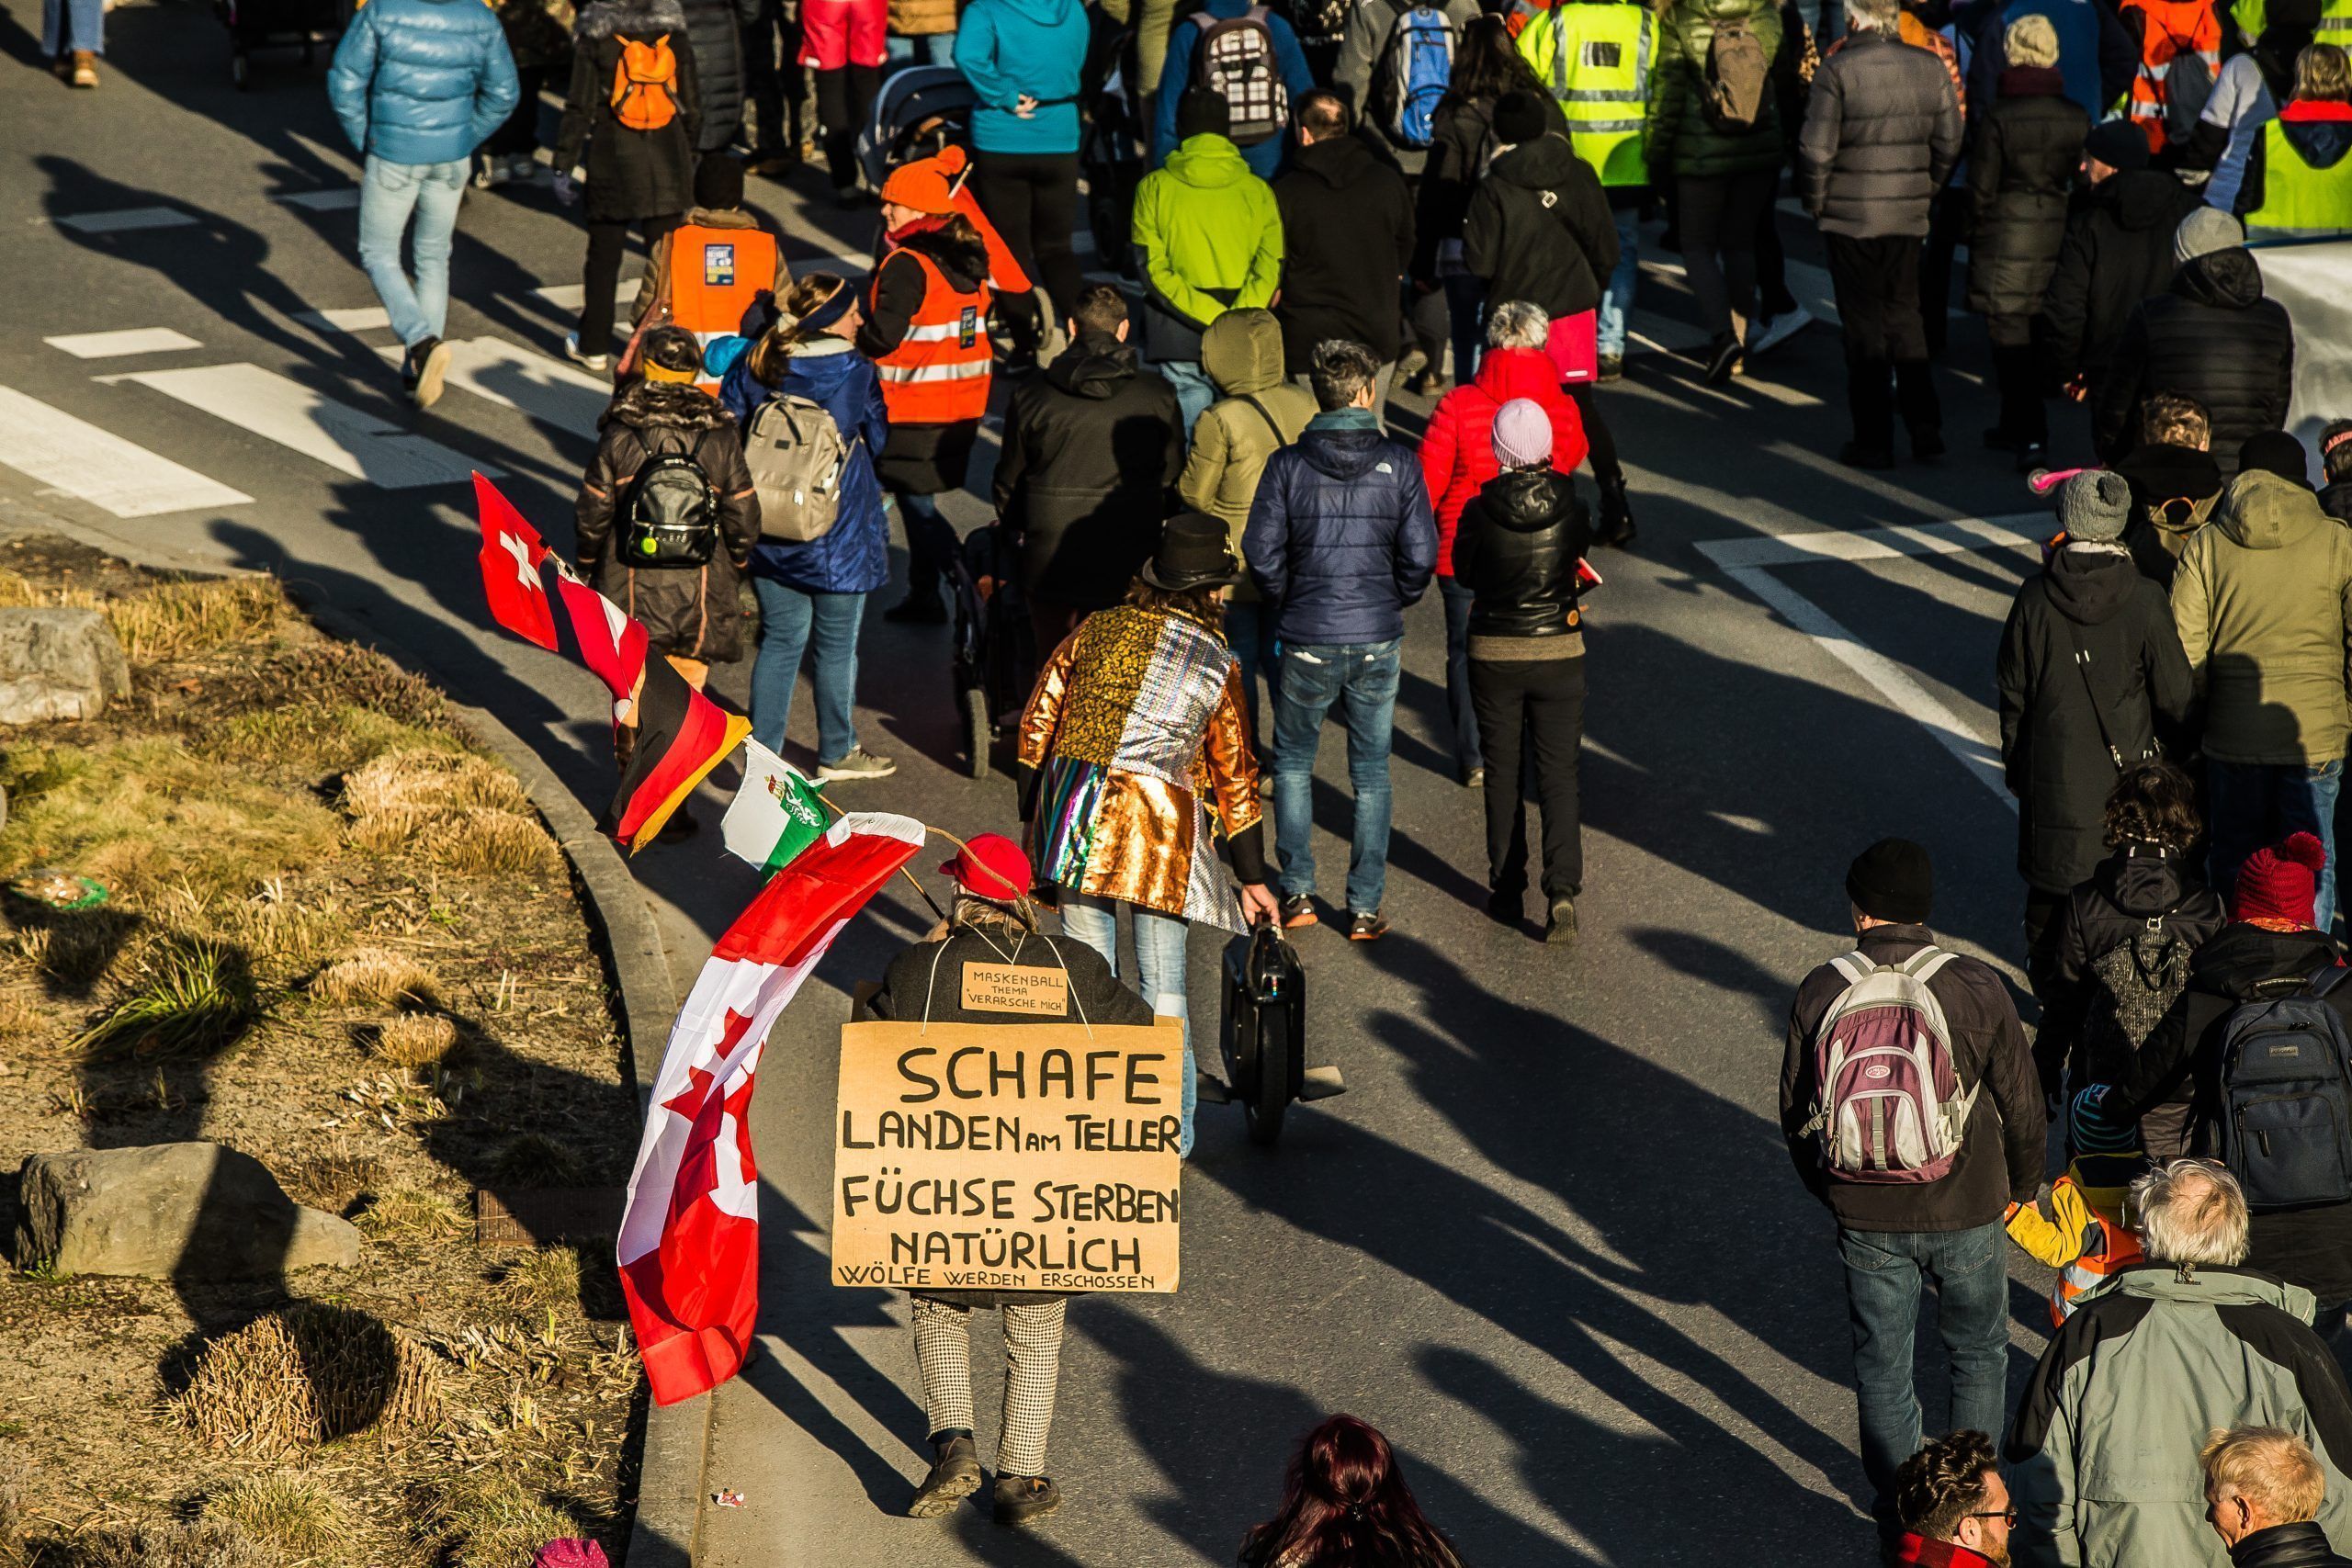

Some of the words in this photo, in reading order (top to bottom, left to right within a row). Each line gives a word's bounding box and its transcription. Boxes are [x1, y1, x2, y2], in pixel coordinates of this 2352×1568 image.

[974, 971, 1064, 988] MASKENBALL
[991, 986, 1028, 996] THEMA
[897, 1046, 1166, 1104] SCHAFE
[842, 1110, 1020, 1154] LANDEN
[1025, 1133, 1060, 1152] AM
[1066, 1114, 1182, 1154] TELLER
[842, 1167, 1015, 1220] FÜCHSE
[1032, 1180, 1179, 1224] STERBEN
[838, 1261, 932, 1286] WÖLFE
[944, 1270, 1025, 1287] WERDEN
[1041, 1271, 1155, 1289] ERSCHOSSEN
